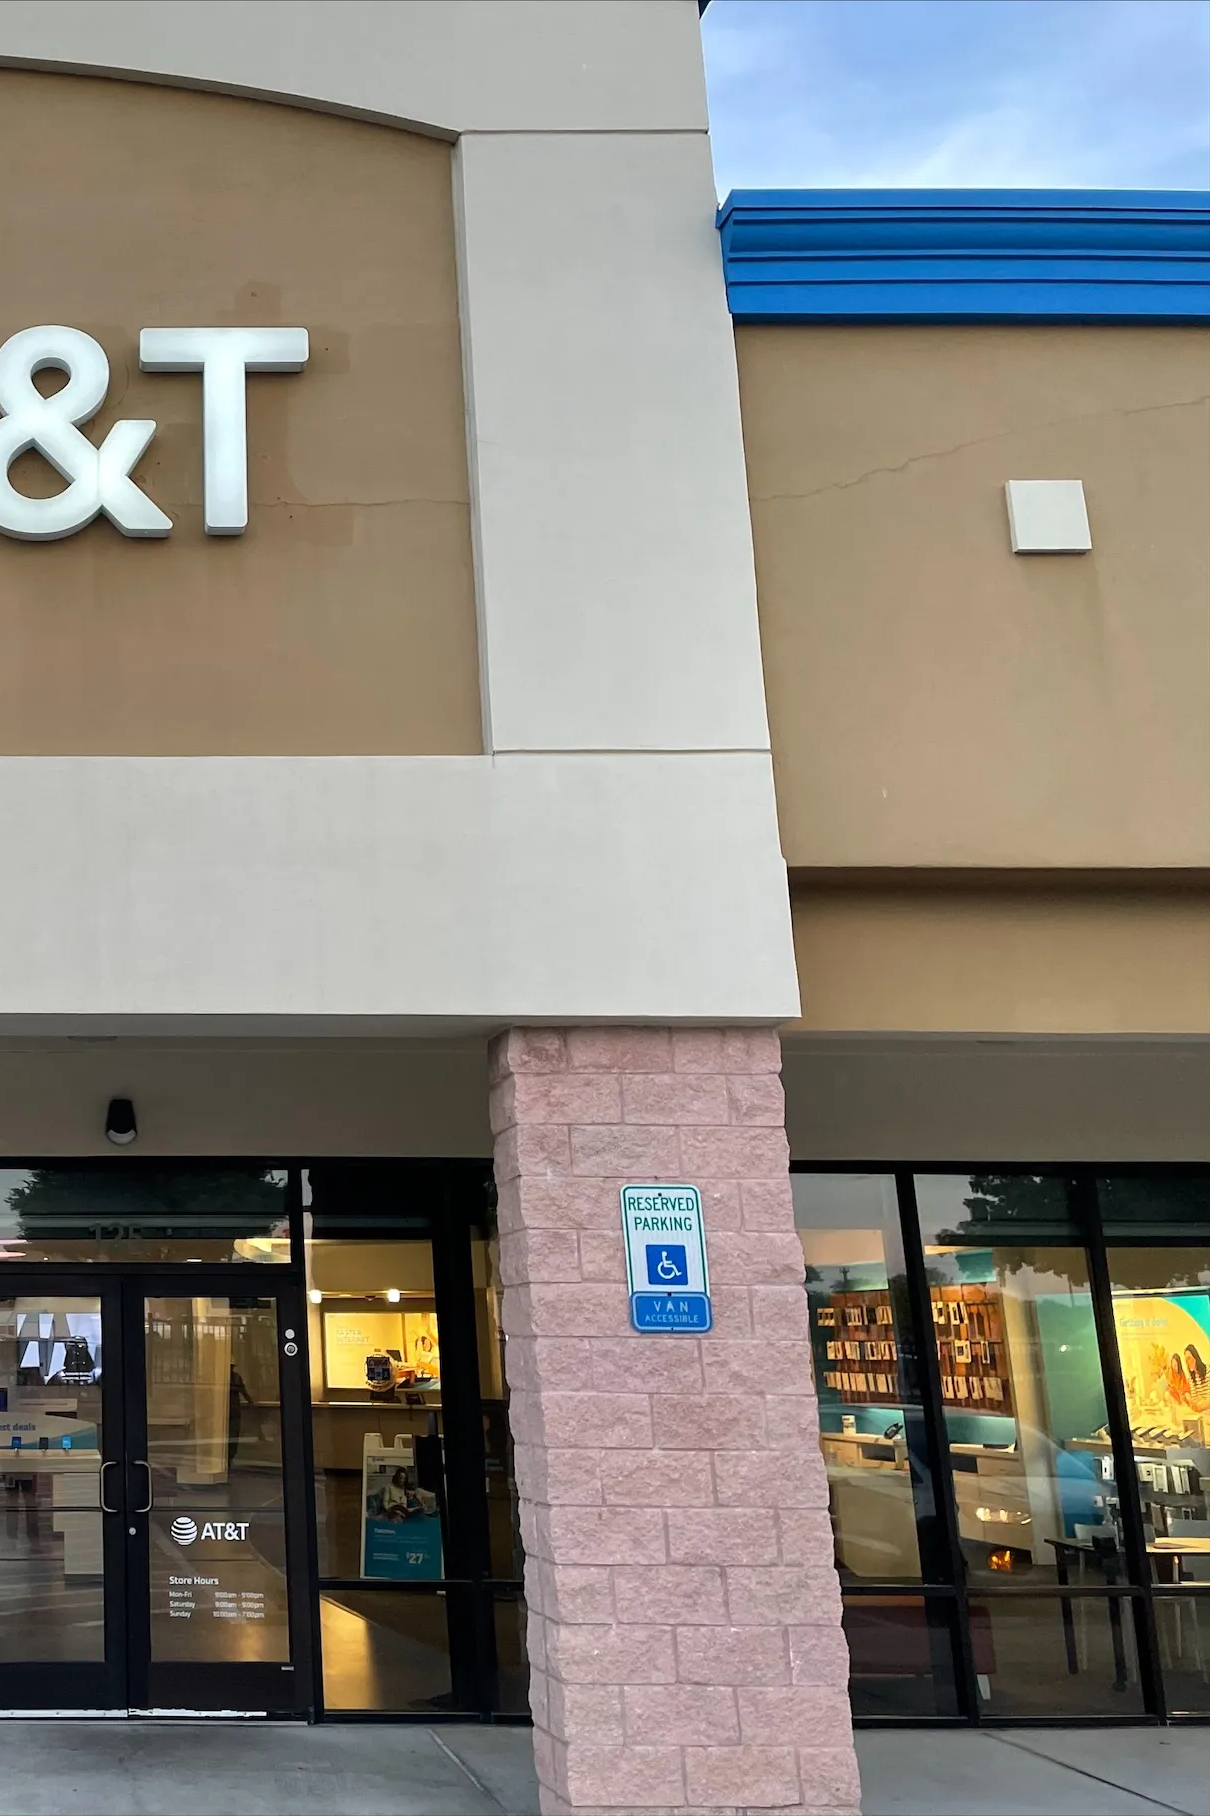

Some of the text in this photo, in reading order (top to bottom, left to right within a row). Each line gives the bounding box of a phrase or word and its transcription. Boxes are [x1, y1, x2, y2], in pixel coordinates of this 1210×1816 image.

[628, 1196, 695, 1212] RESERVED
[634, 1217, 693, 1231] PARKING
[653, 1300, 689, 1313] VAN
[644, 1314, 699, 1324] ACCESSIBLE
[12, 1422, 36, 1431] deals
[200, 1522, 250, 1541] AT&T
[169, 1576, 219, 1585] Store Hours
[169, 1600, 196, 1609] Saturday
[169, 1610, 191, 1618] Sunday
